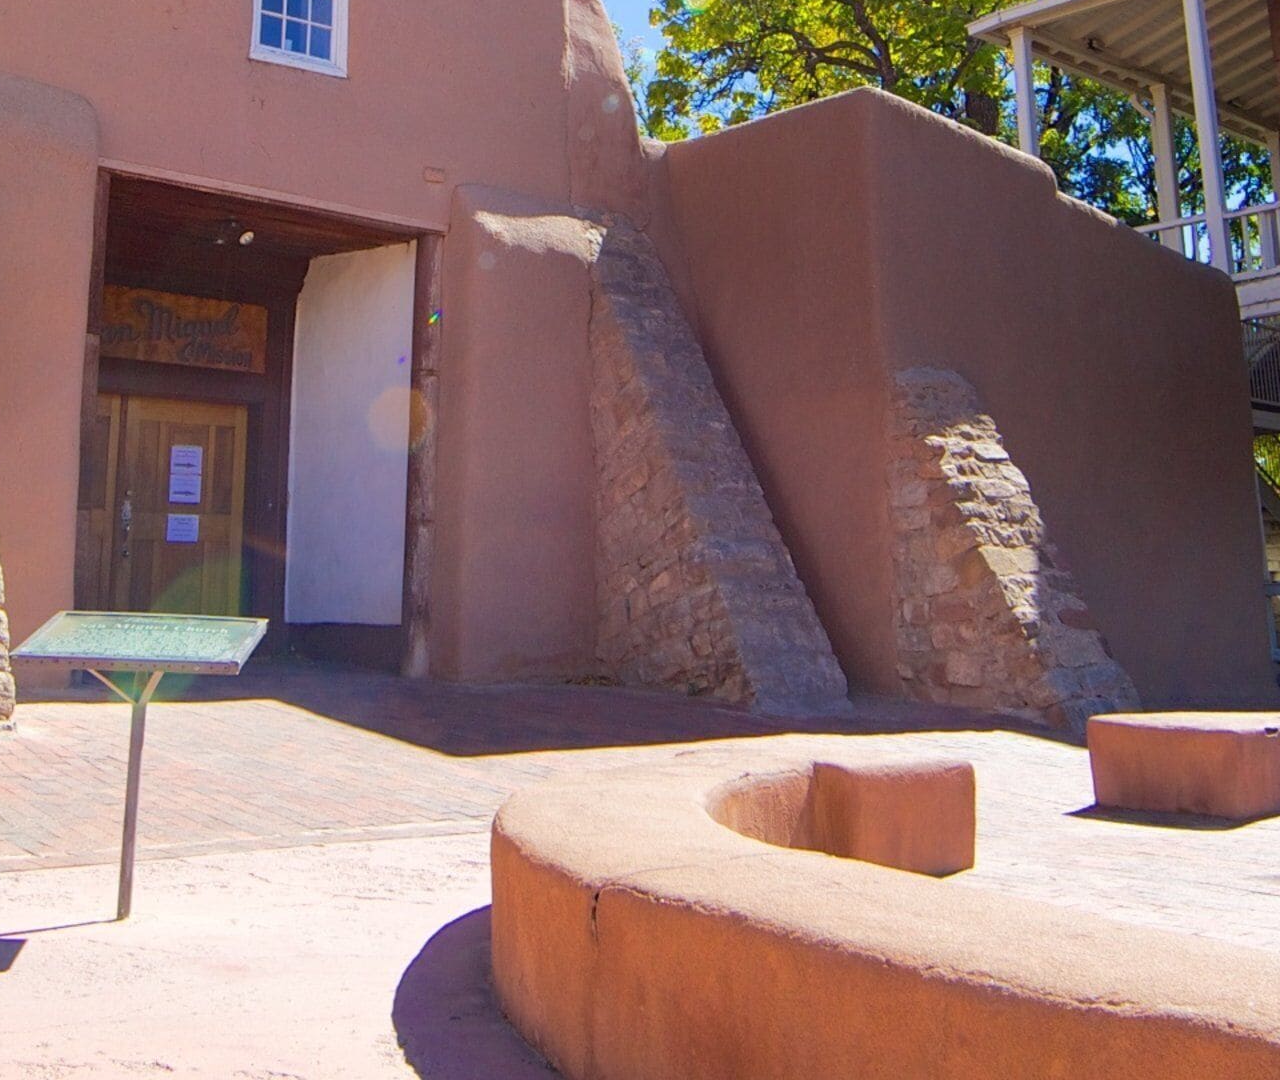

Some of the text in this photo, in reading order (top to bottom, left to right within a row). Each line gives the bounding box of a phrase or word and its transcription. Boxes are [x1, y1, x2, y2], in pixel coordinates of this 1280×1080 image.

[101, 297, 241, 361] an Miguel
[117, 622, 168, 631] Miguel
[174, 625, 229, 633] Church
